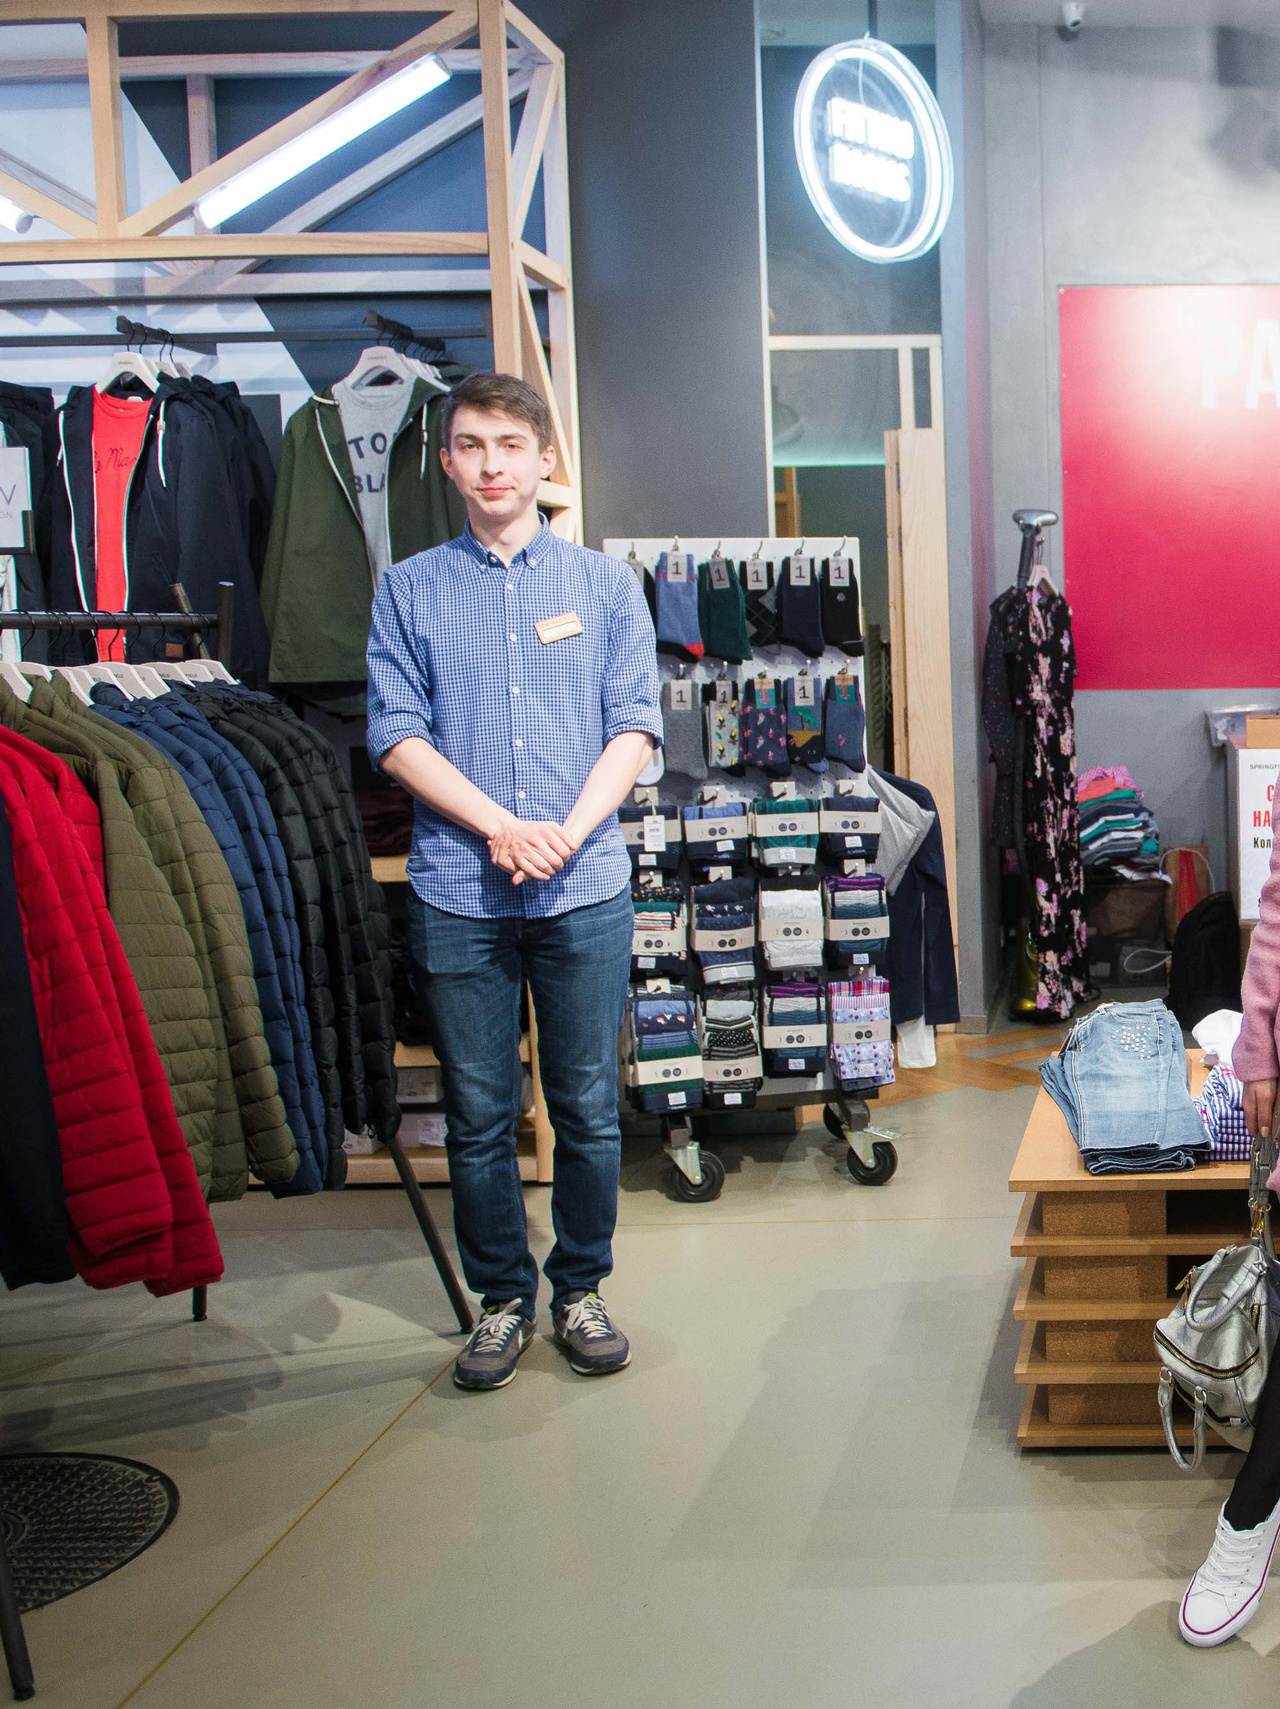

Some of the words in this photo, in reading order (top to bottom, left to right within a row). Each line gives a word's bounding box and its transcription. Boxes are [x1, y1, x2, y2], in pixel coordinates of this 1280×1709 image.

[348, 432, 398, 459] TO
[672, 562, 681, 575] 1
[714, 568, 724, 581] 1
[795, 565, 805, 578] 1
[834, 566, 844, 579] 1
[752, 569, 762, 582] 1
[676, 690, 687, 703] 1
[720, 690, 728, 703] 1
[760, 688, 771, 702] 1
[799, 685, 809, 698] 1
[840, 685, 850, 698] 1
